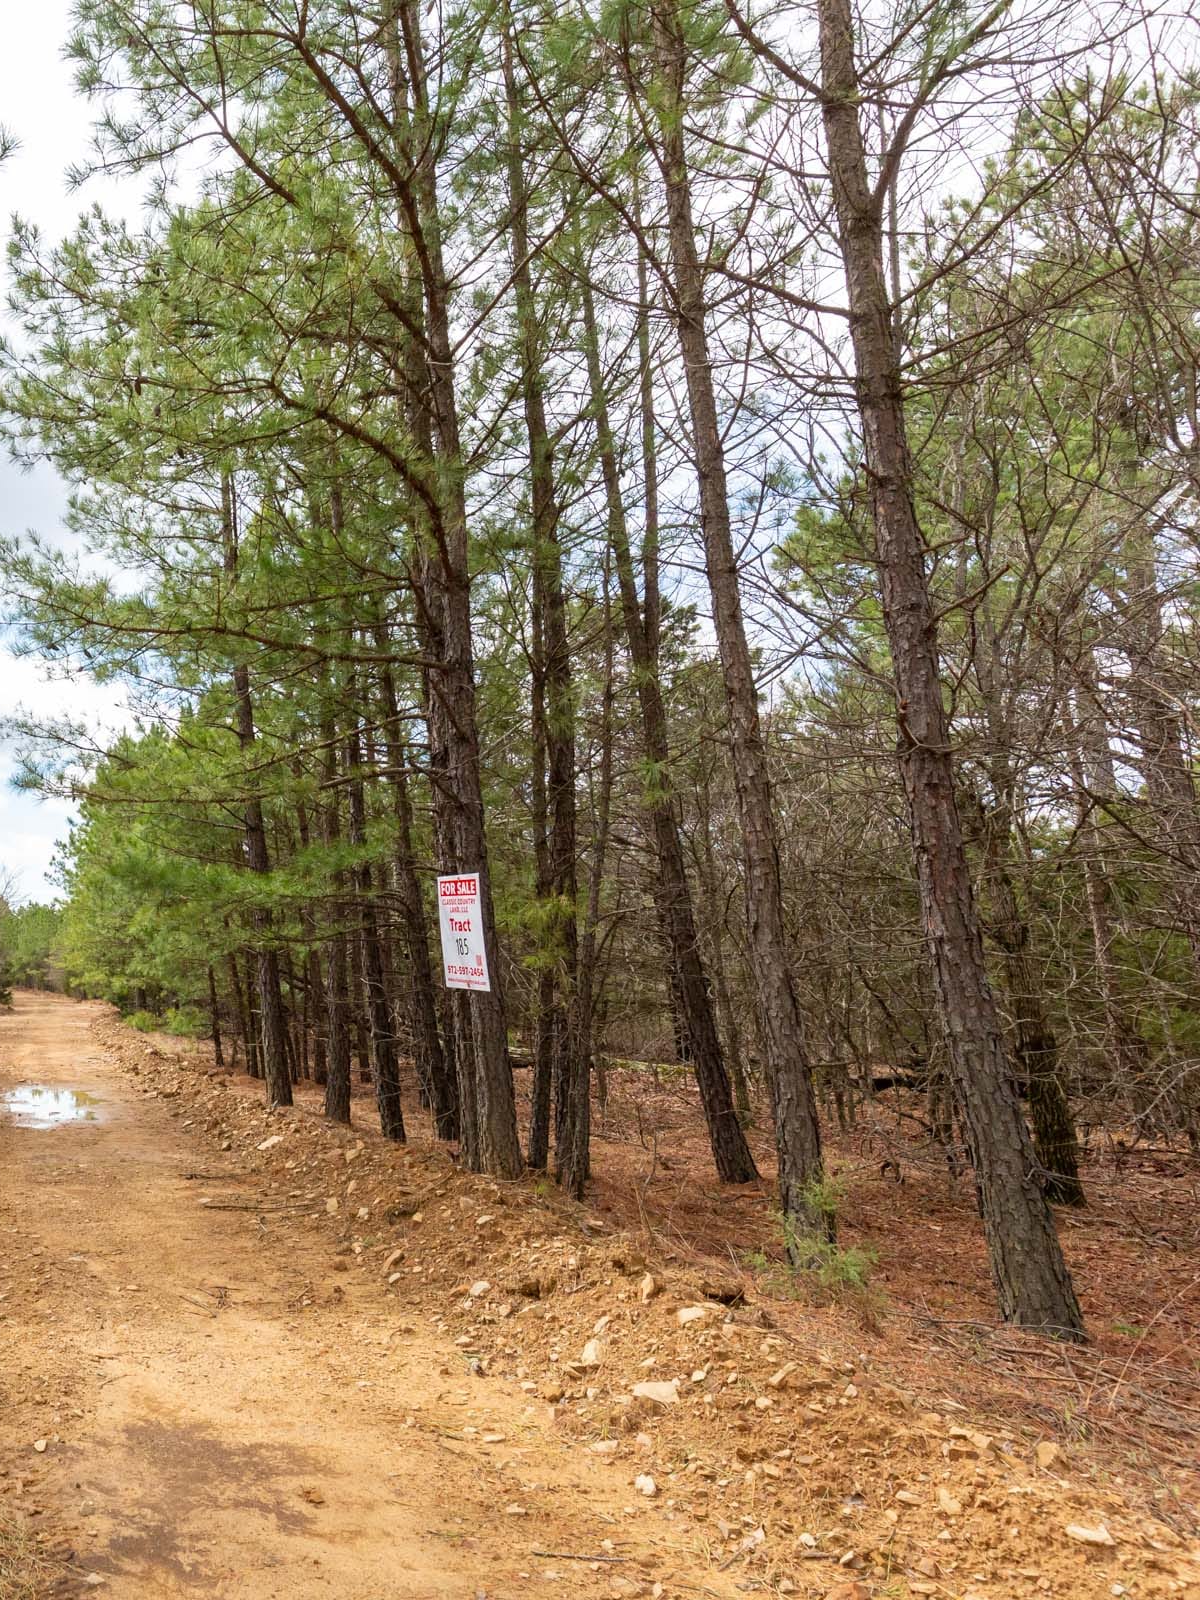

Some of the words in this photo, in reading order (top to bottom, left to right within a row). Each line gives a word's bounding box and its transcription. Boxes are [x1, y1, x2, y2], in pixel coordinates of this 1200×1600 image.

[441, 882, 456, 895] FOR
[457, 881, 476, 894] SALE
[449, 918, 471, 932] Tract
[456, 938, 469, 955] 185
